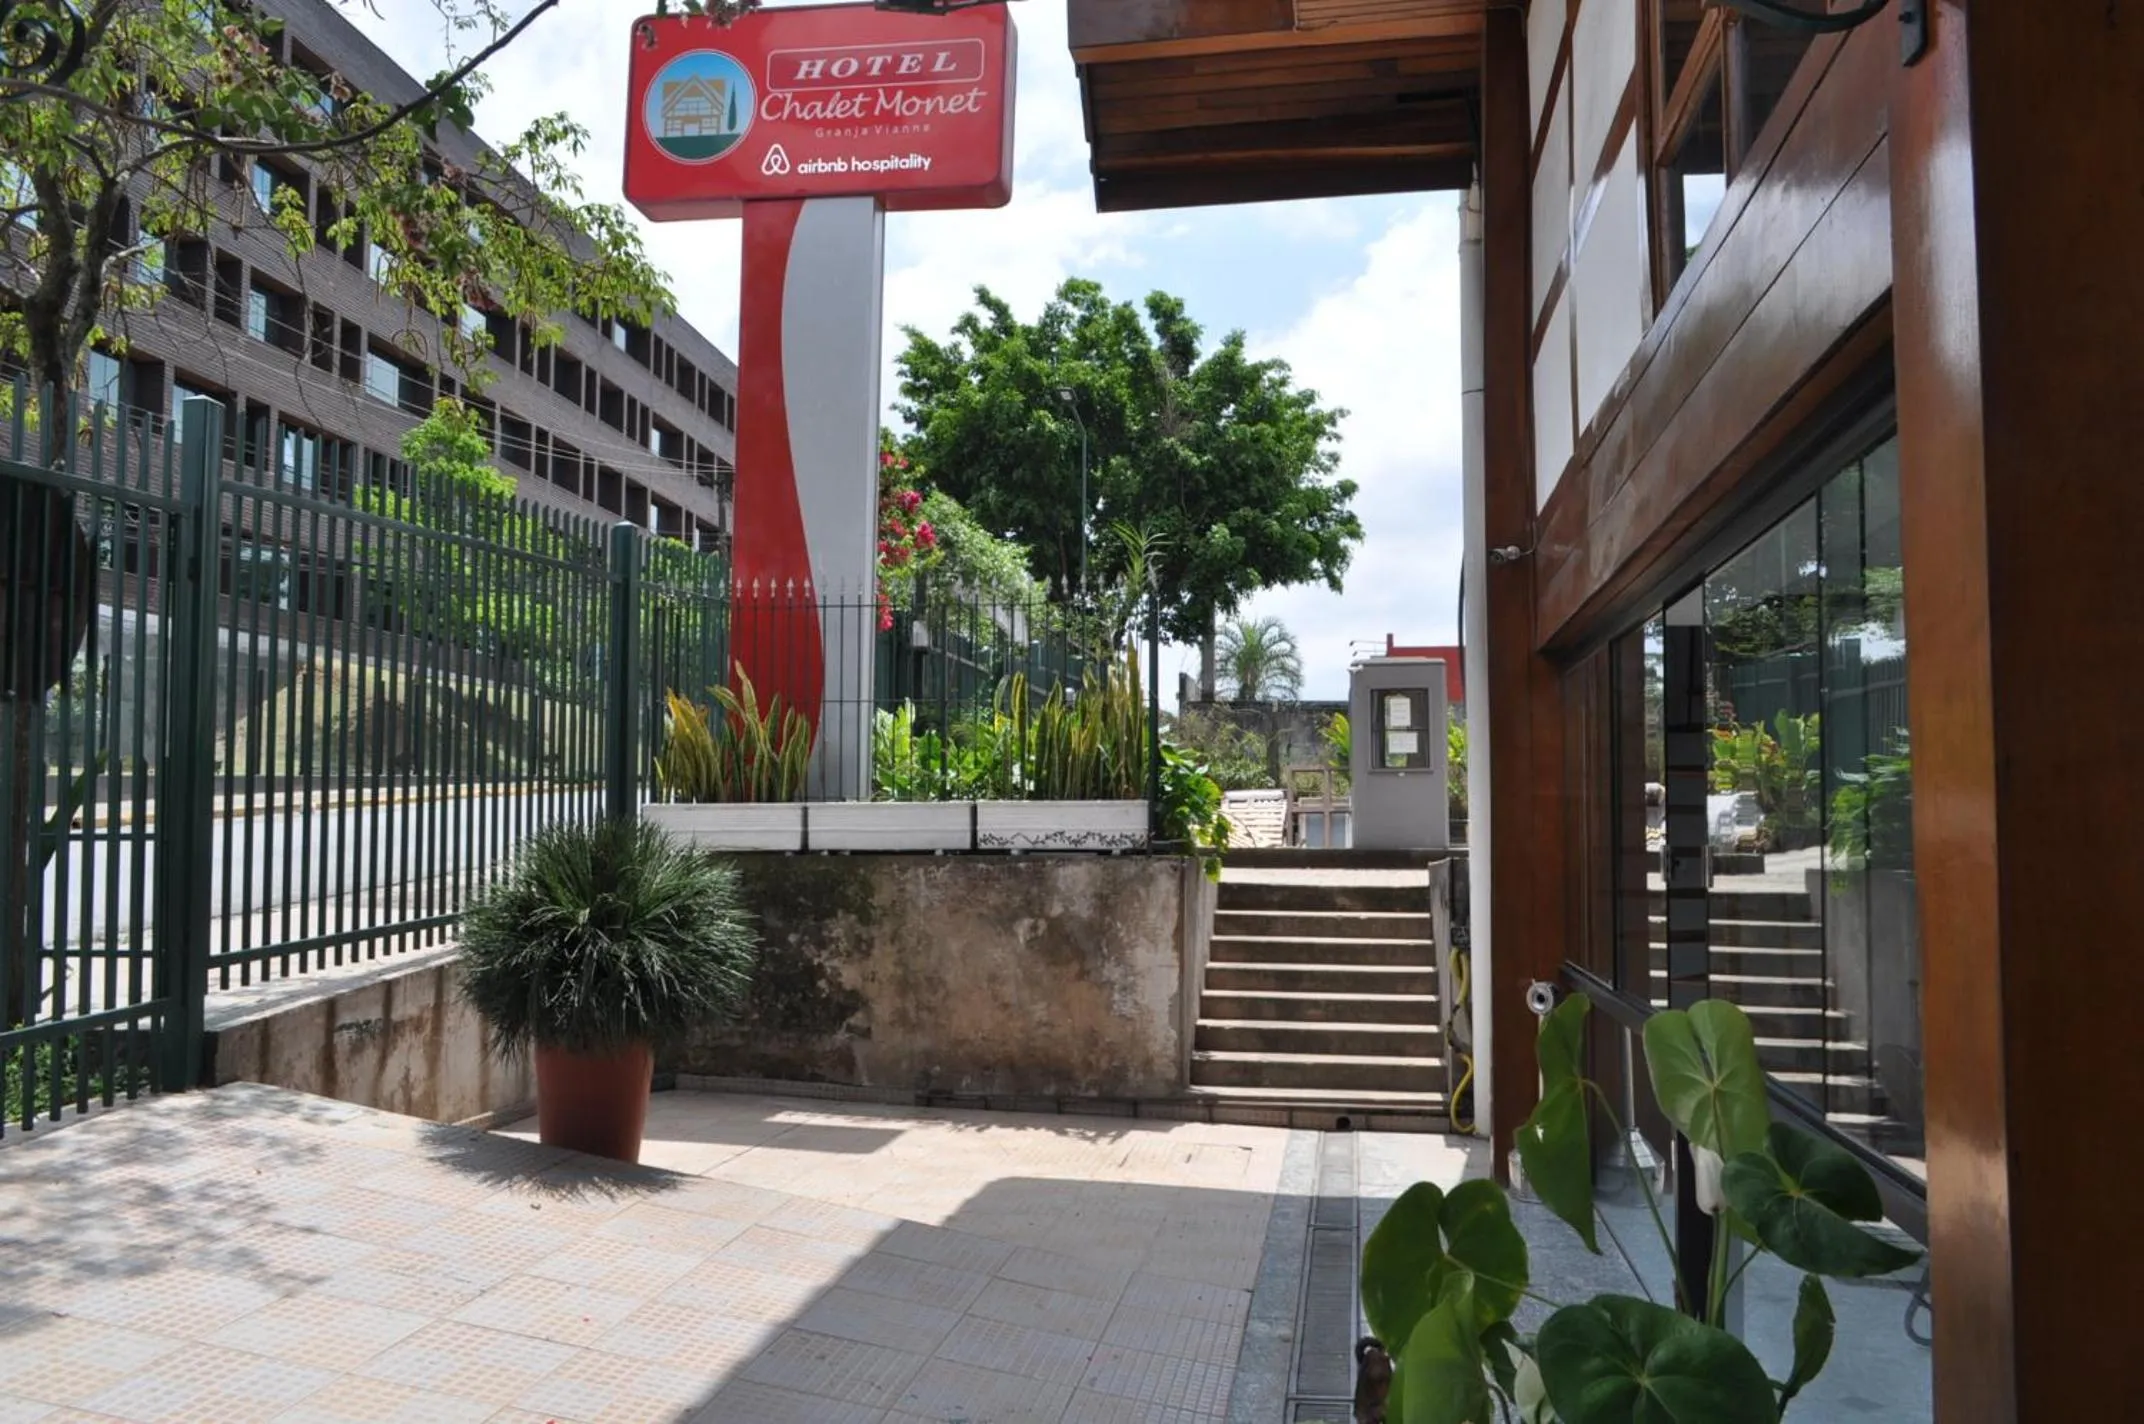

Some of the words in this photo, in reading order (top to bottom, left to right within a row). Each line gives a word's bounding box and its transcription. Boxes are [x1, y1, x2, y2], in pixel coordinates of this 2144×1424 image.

[794, 51, 957, 80] HOTEL
[760, 91, 873, 121] Chalet
[873, 87, 987, 117] Monet
[815, 126, 869, 139] Granja
[797, 157, 848, 174] airbnb
[851, 154, 932, 173] hospitality
